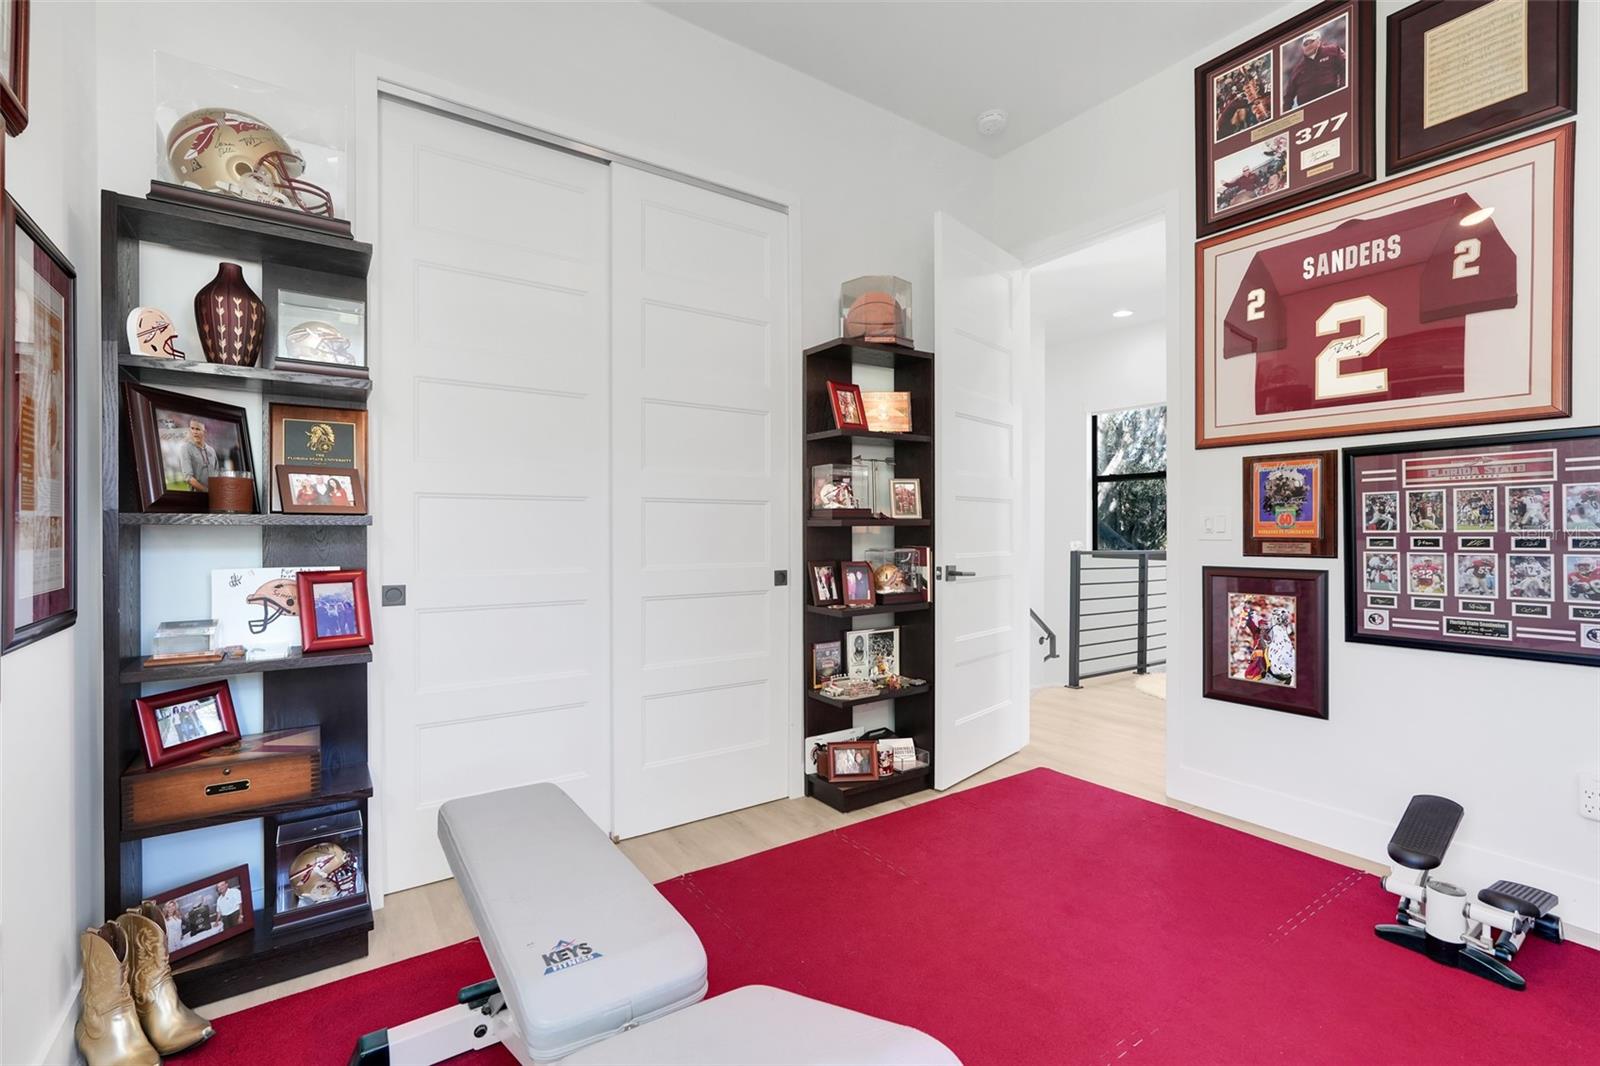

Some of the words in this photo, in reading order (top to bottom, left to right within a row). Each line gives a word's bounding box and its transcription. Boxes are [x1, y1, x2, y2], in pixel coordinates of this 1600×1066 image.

[1295, 112, 1348, 145] 377
[1302, 234, 1401, 280] SANDERS
[1452, 238, 1481, 279] 2
[1247, 287, 1266, 321] 2
[1315, 295, 1388, 400] 2
[1427, 466, 1480, 477] FLORIDA
[1483, 463, 1526, 473] STATE
[541, 943, 593, 967] KEYS
